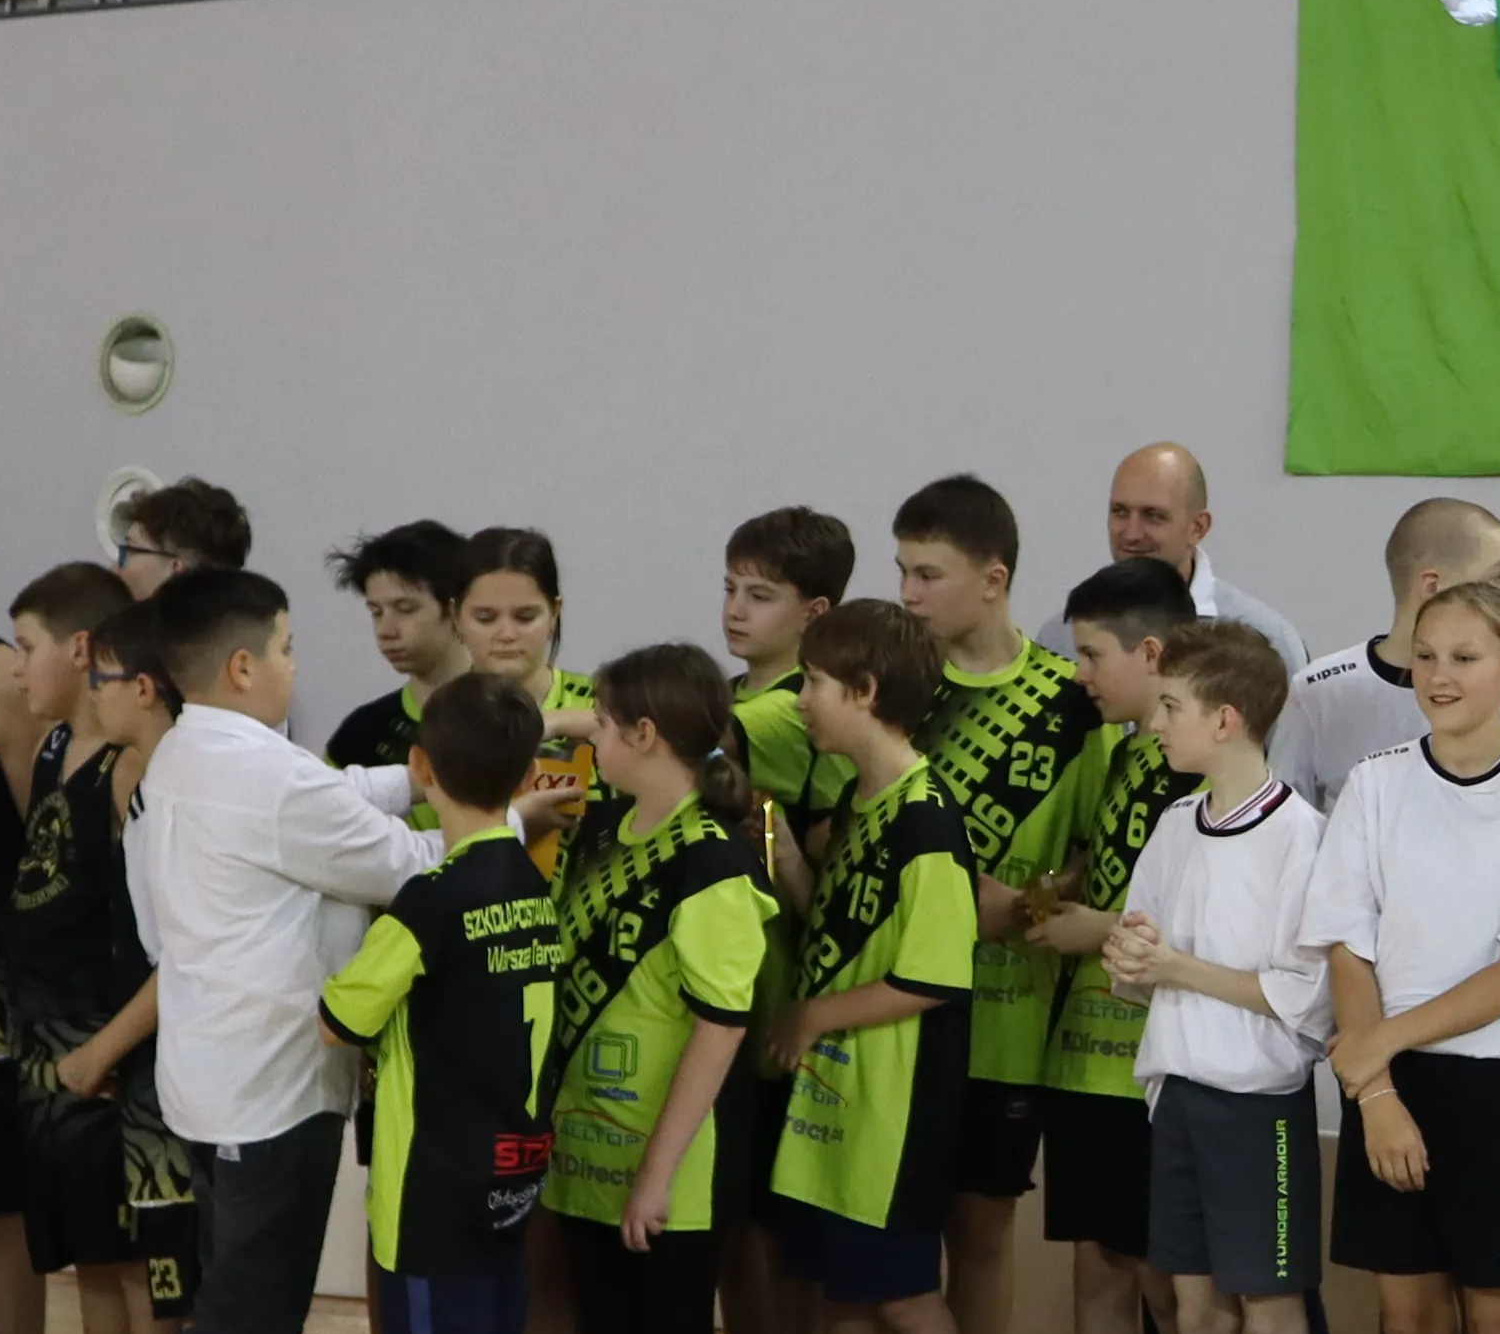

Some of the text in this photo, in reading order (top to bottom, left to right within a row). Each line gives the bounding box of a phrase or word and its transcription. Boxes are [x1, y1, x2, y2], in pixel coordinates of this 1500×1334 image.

[1306, 661, 1358, 685] kipsta
[1008, 740, 1056, 792] 23
[1126, 802, 1148, 849] 6
[847, 871, 884, 926] 15
[607, 907, 643, 963] 12
[1275, 1119, 1289, 1257] UNDER ARMOUR
[148, 1258, 182, 1299] 23
